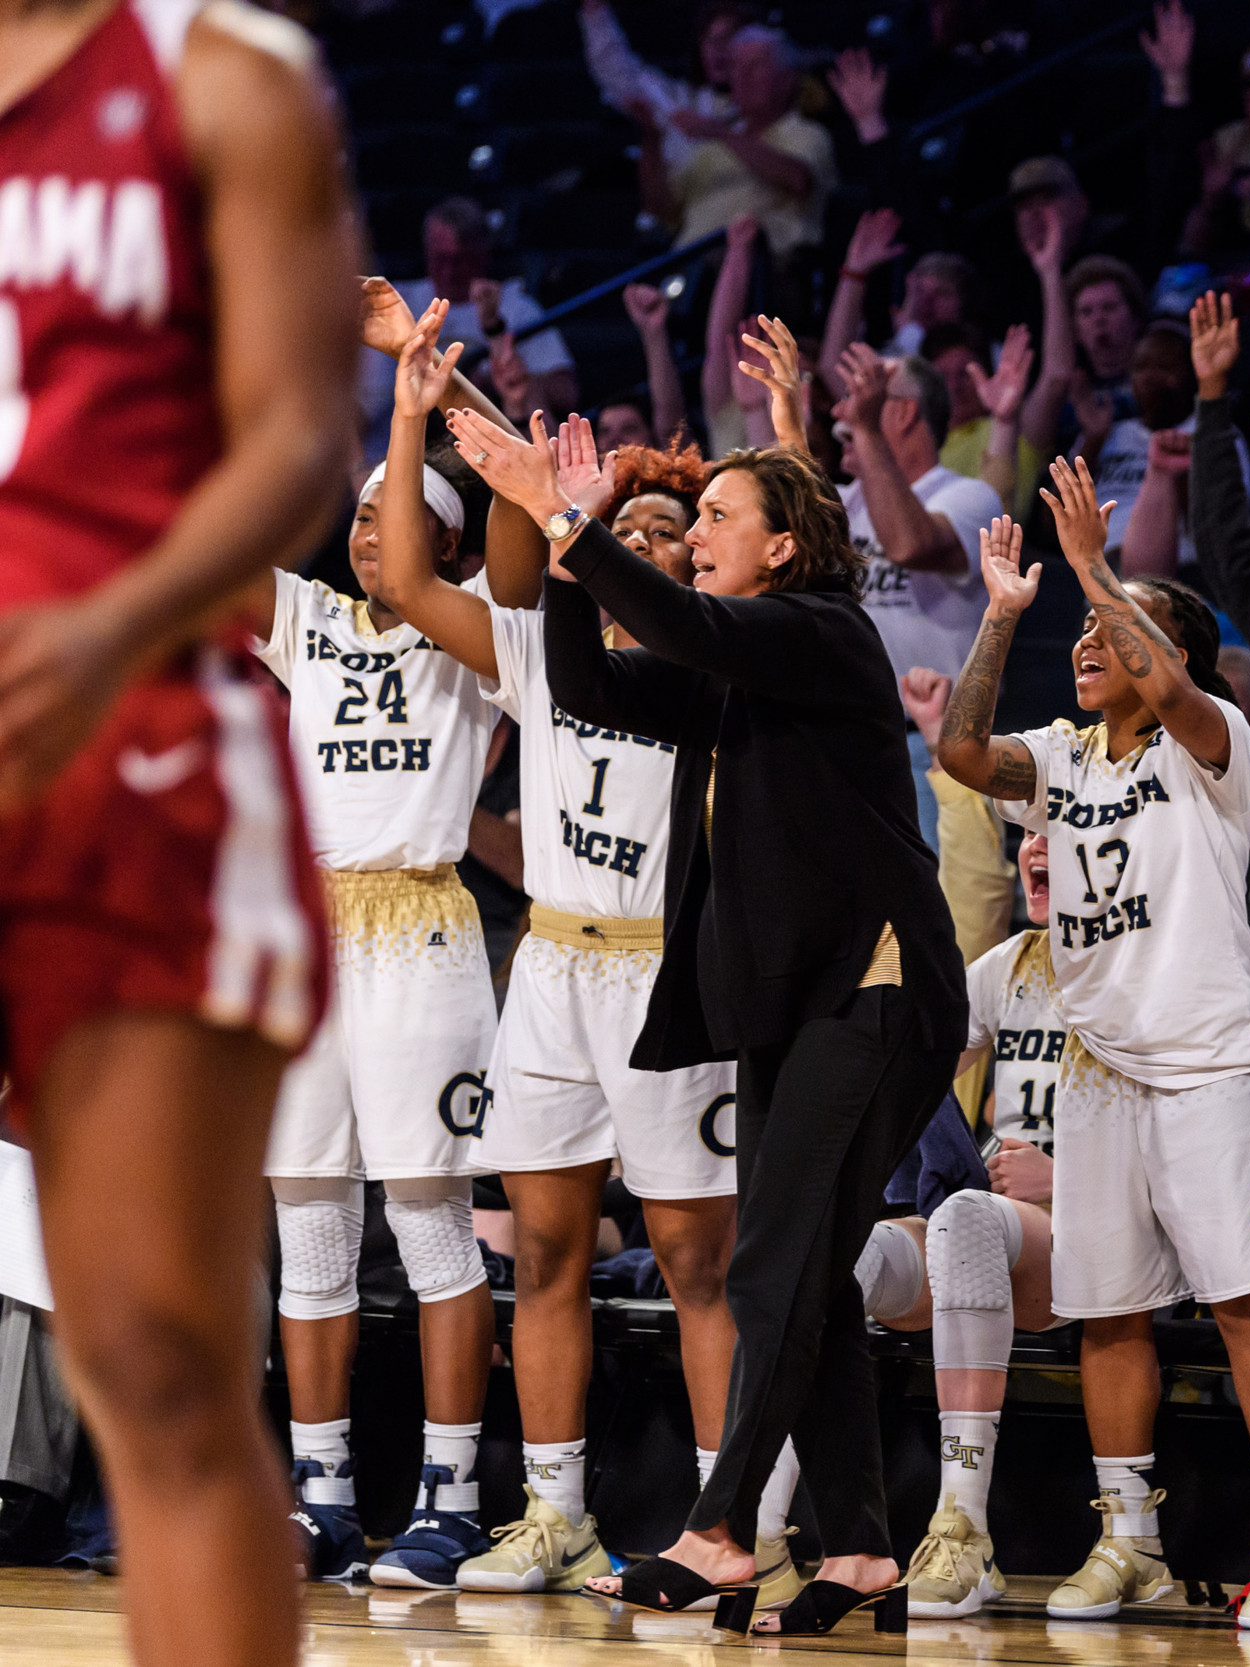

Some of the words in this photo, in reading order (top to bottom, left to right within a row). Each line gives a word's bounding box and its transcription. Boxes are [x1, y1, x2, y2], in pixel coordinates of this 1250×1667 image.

[335, 668, 408, 726] 24
[317, 738, 432, 773] TECH
[581, 756, 612, 819] 1
[1075, 838, 1132, 904] 13
[1057, 893, 1152, 949] TECH
[940, 1435, 985, 1470] GT
